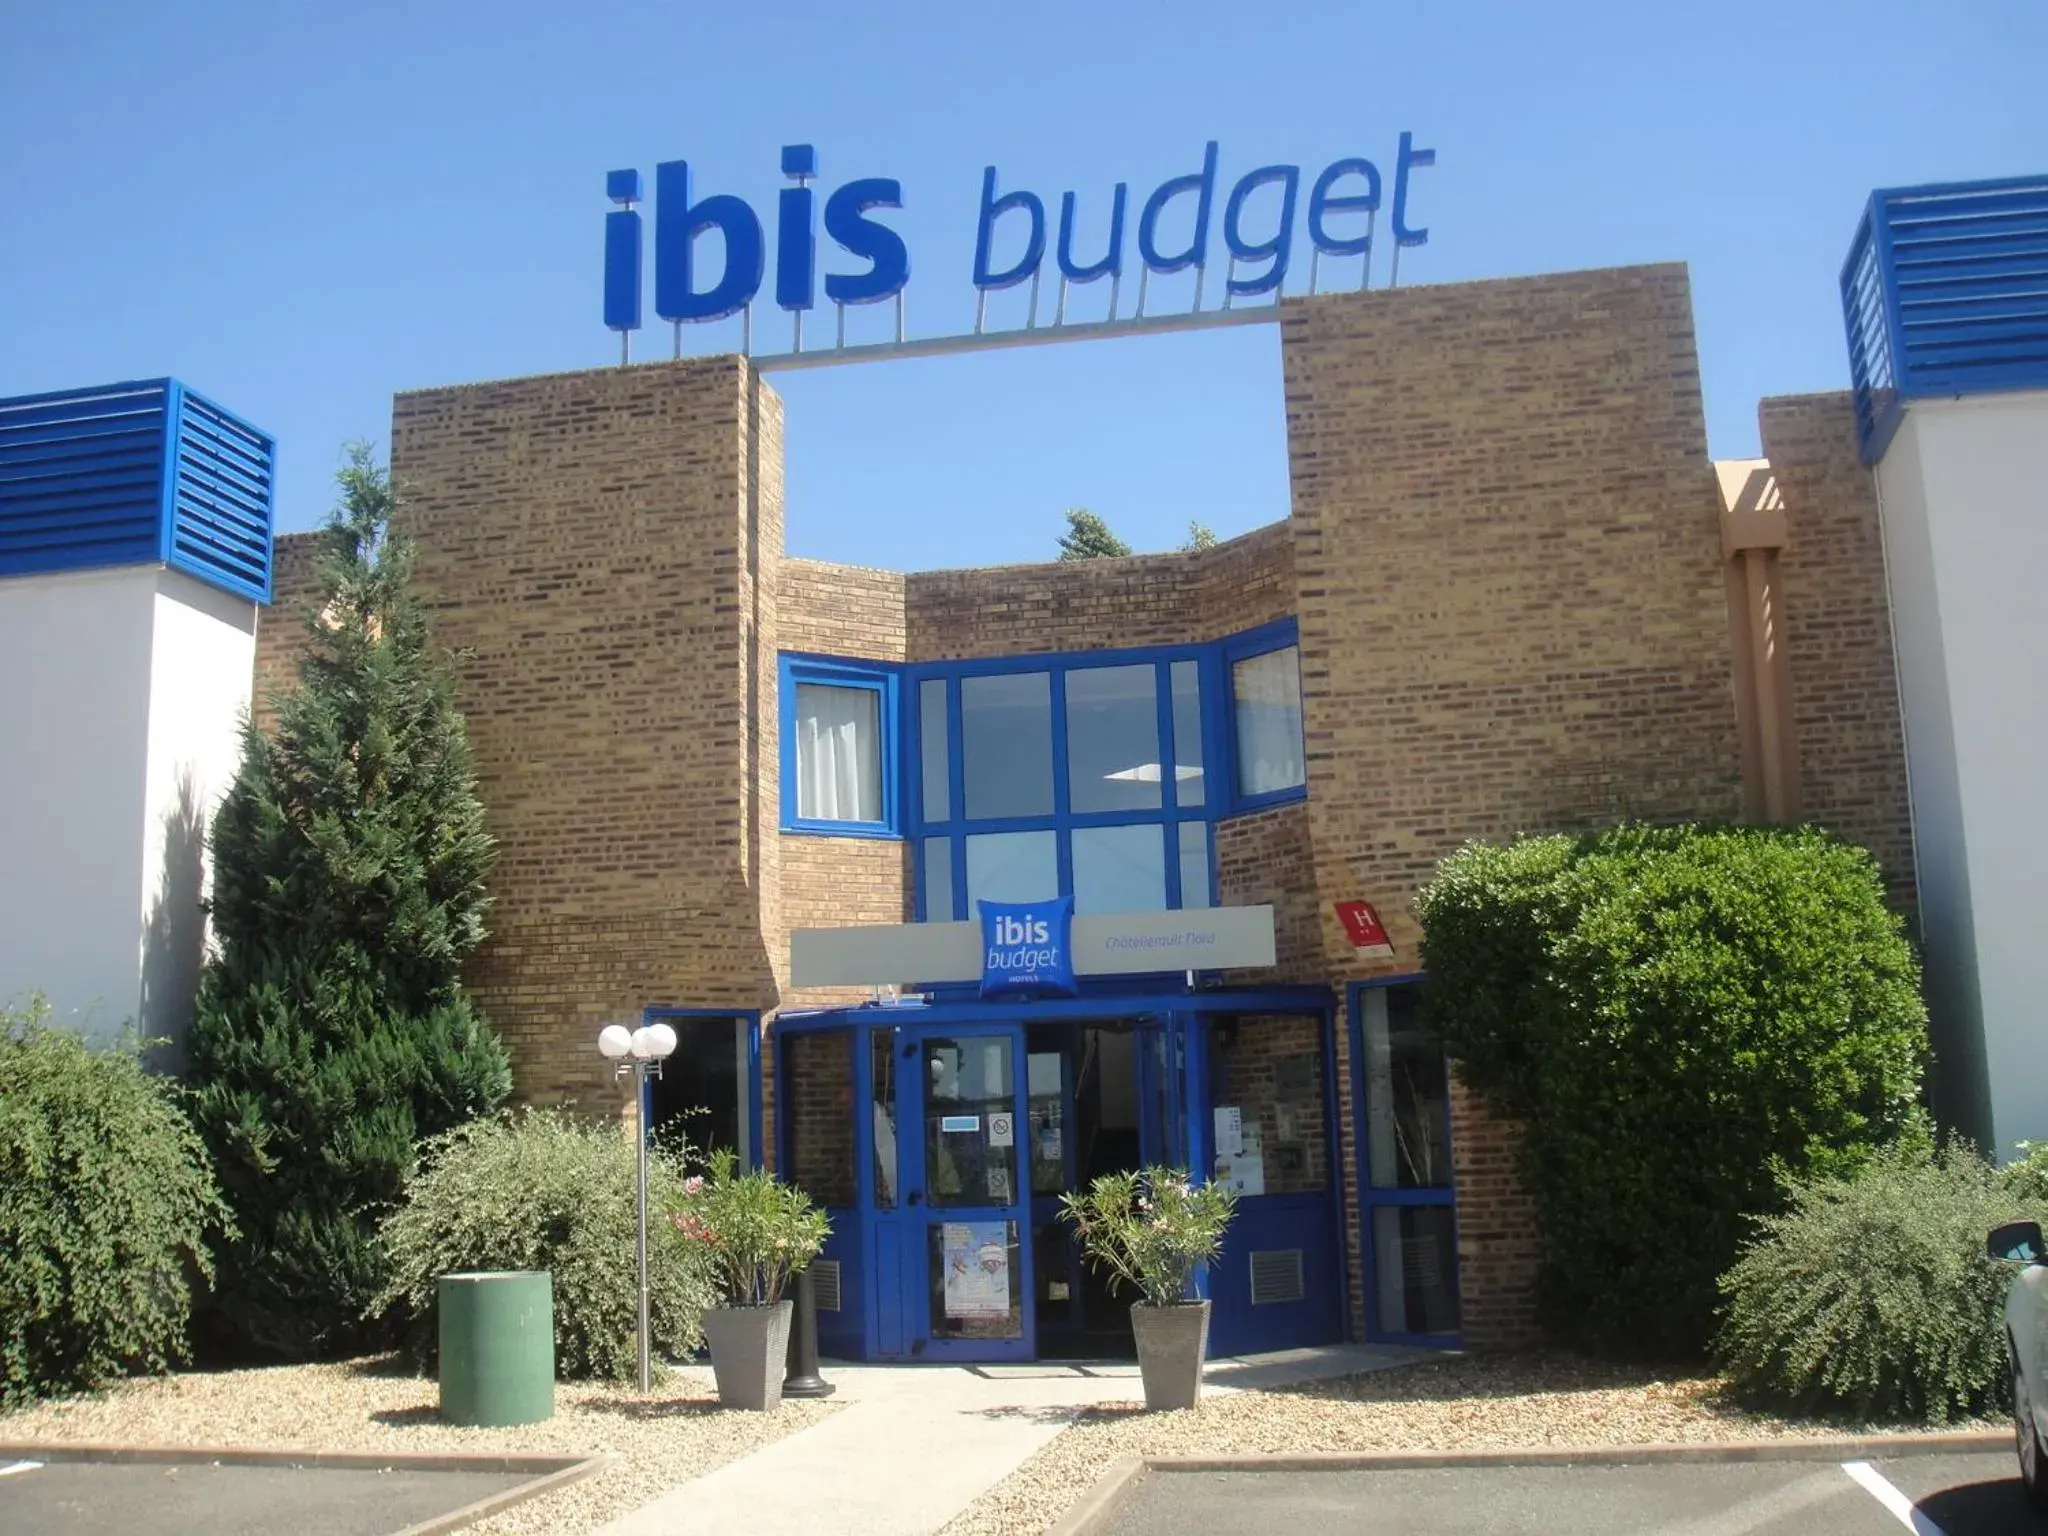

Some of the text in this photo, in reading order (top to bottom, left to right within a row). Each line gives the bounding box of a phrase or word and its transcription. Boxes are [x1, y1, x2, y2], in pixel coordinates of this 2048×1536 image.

[603, 130, 1436, 331] ibis budget
[996, 914, 1049, 945] ibis
[1353, 910, 1374, 926] H
[987, 946, 1058, 972] budget
